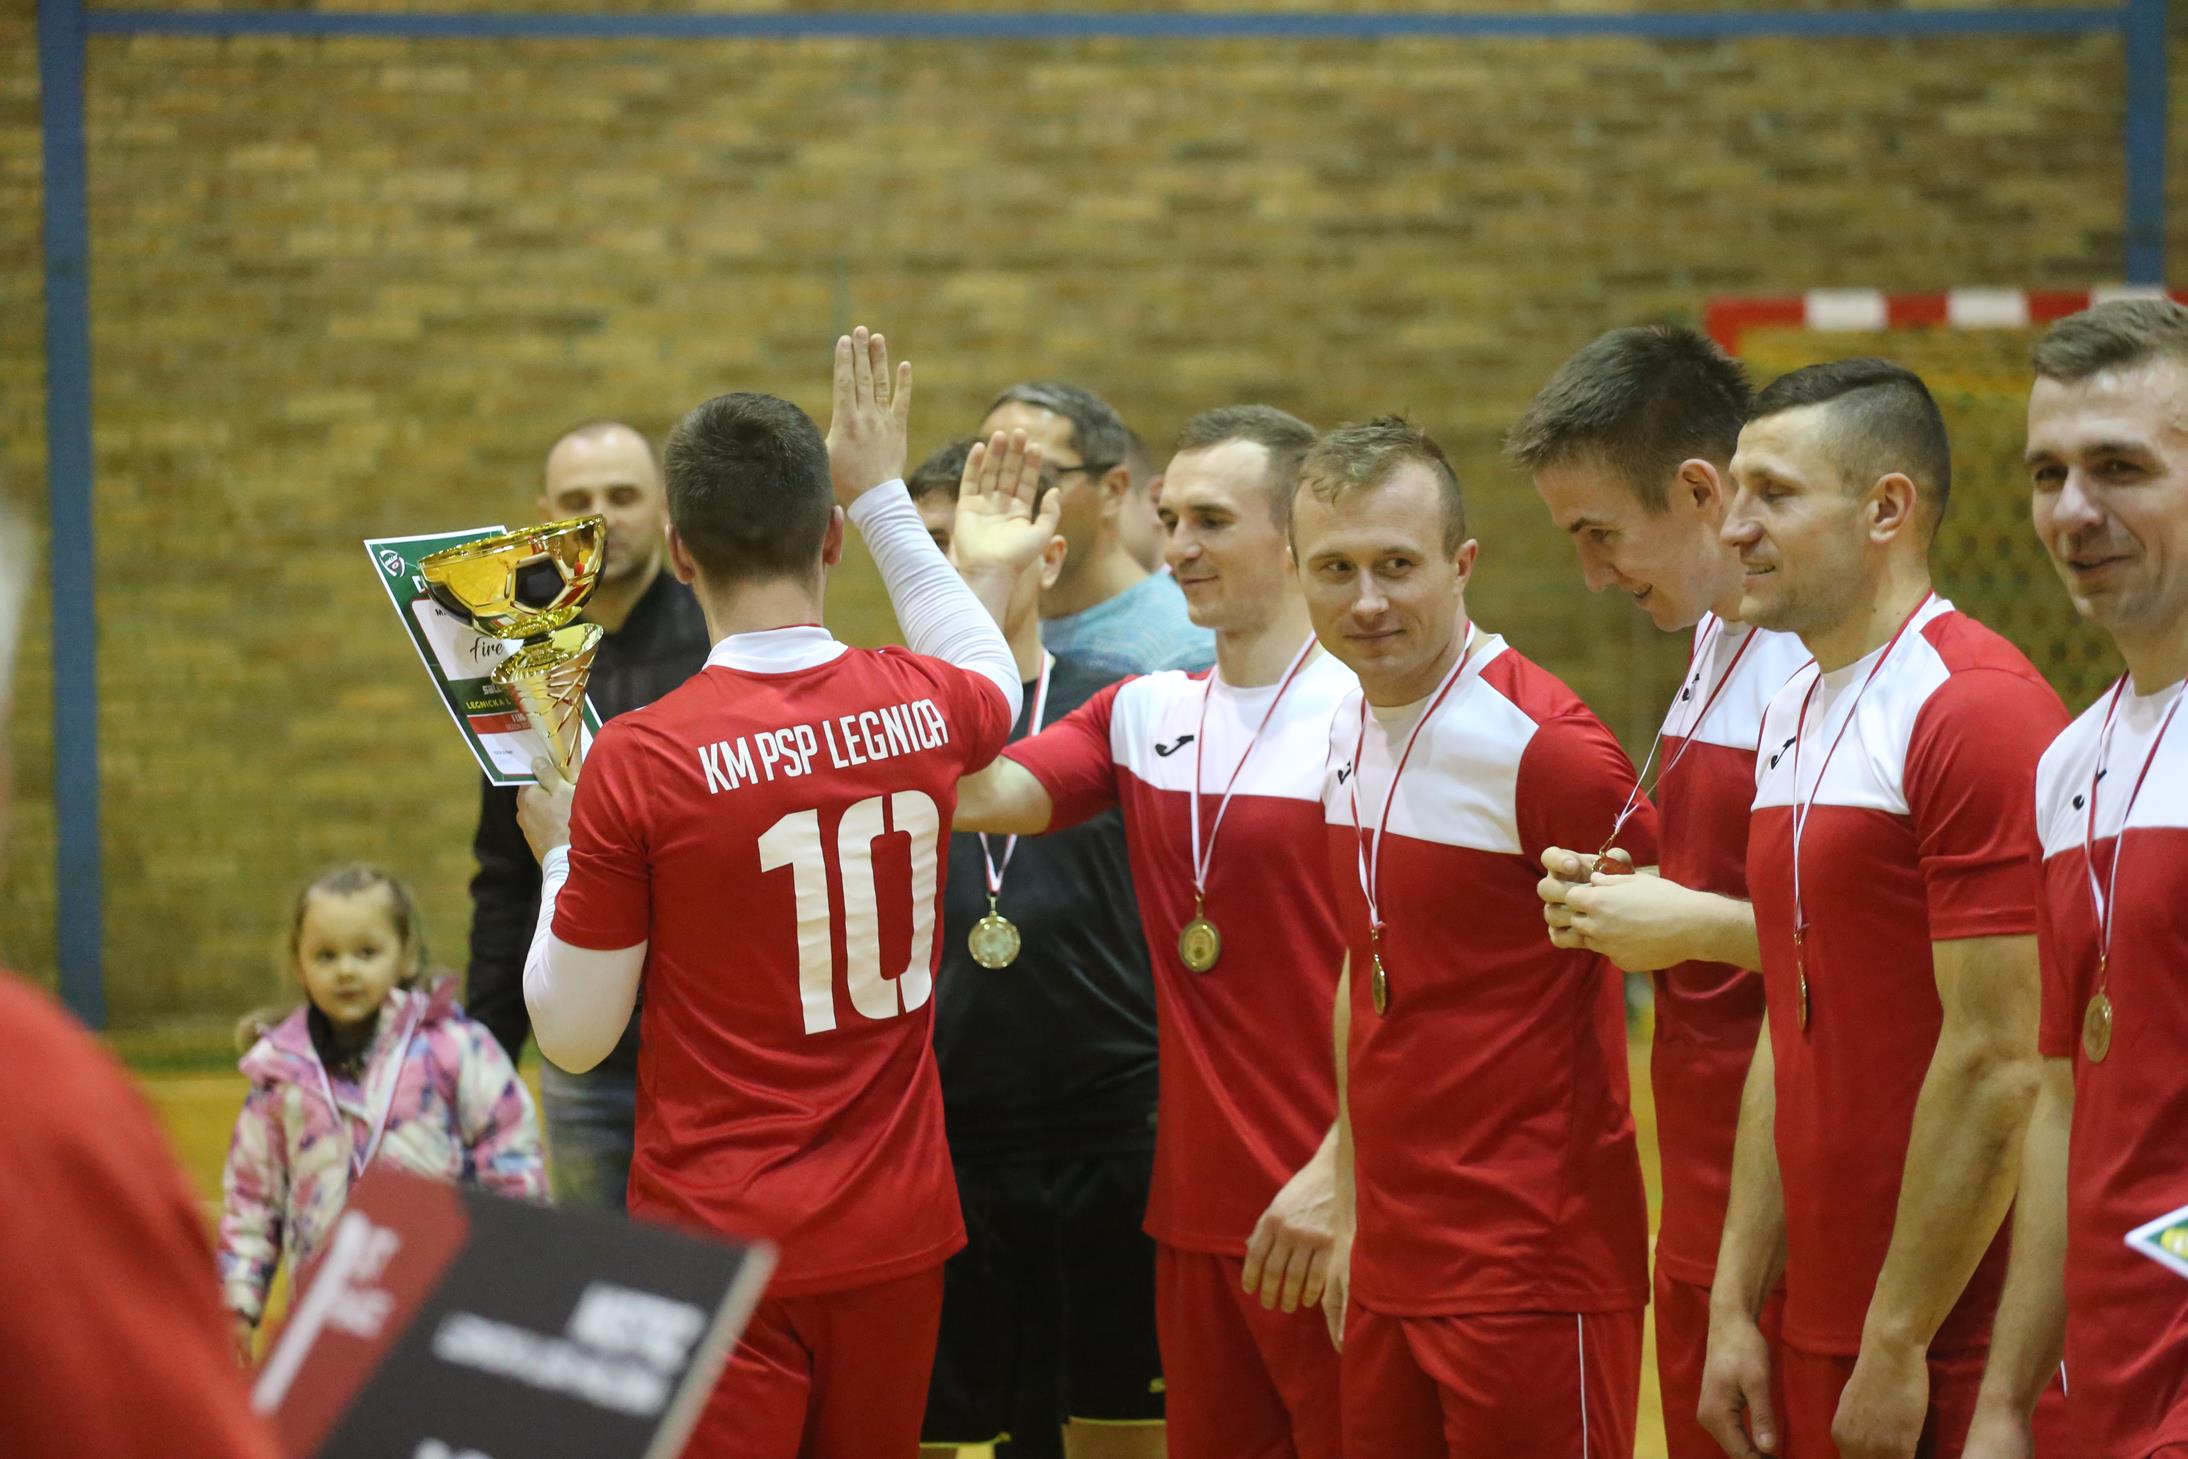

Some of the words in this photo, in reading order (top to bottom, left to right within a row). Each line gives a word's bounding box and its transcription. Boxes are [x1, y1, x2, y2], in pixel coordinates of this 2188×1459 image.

[470, 636, 504, 664] fire
[697, 737, 758, 794] KM
[754, 724, 817, 781] PSP
[822, 698, 949, 769] LEGNICA
[757, 789, 940, 1035] 10
